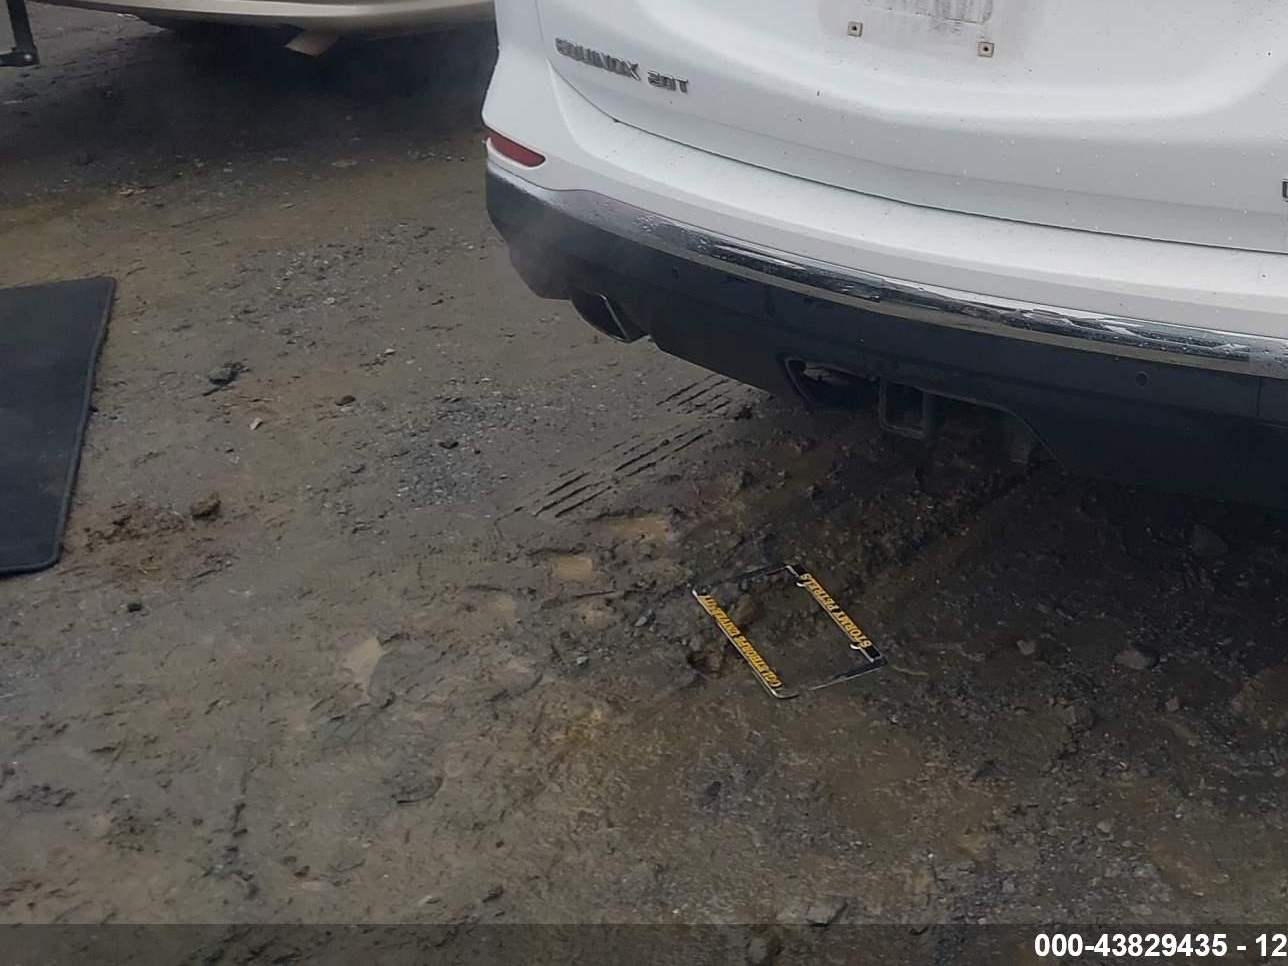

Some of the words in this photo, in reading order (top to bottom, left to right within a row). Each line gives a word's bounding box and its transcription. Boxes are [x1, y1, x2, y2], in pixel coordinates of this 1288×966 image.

[555, 37, 641, 81] EQUINOX
[799, 572, 840, 612] PETRELS
[832, 610, 873, 649] STORMY
